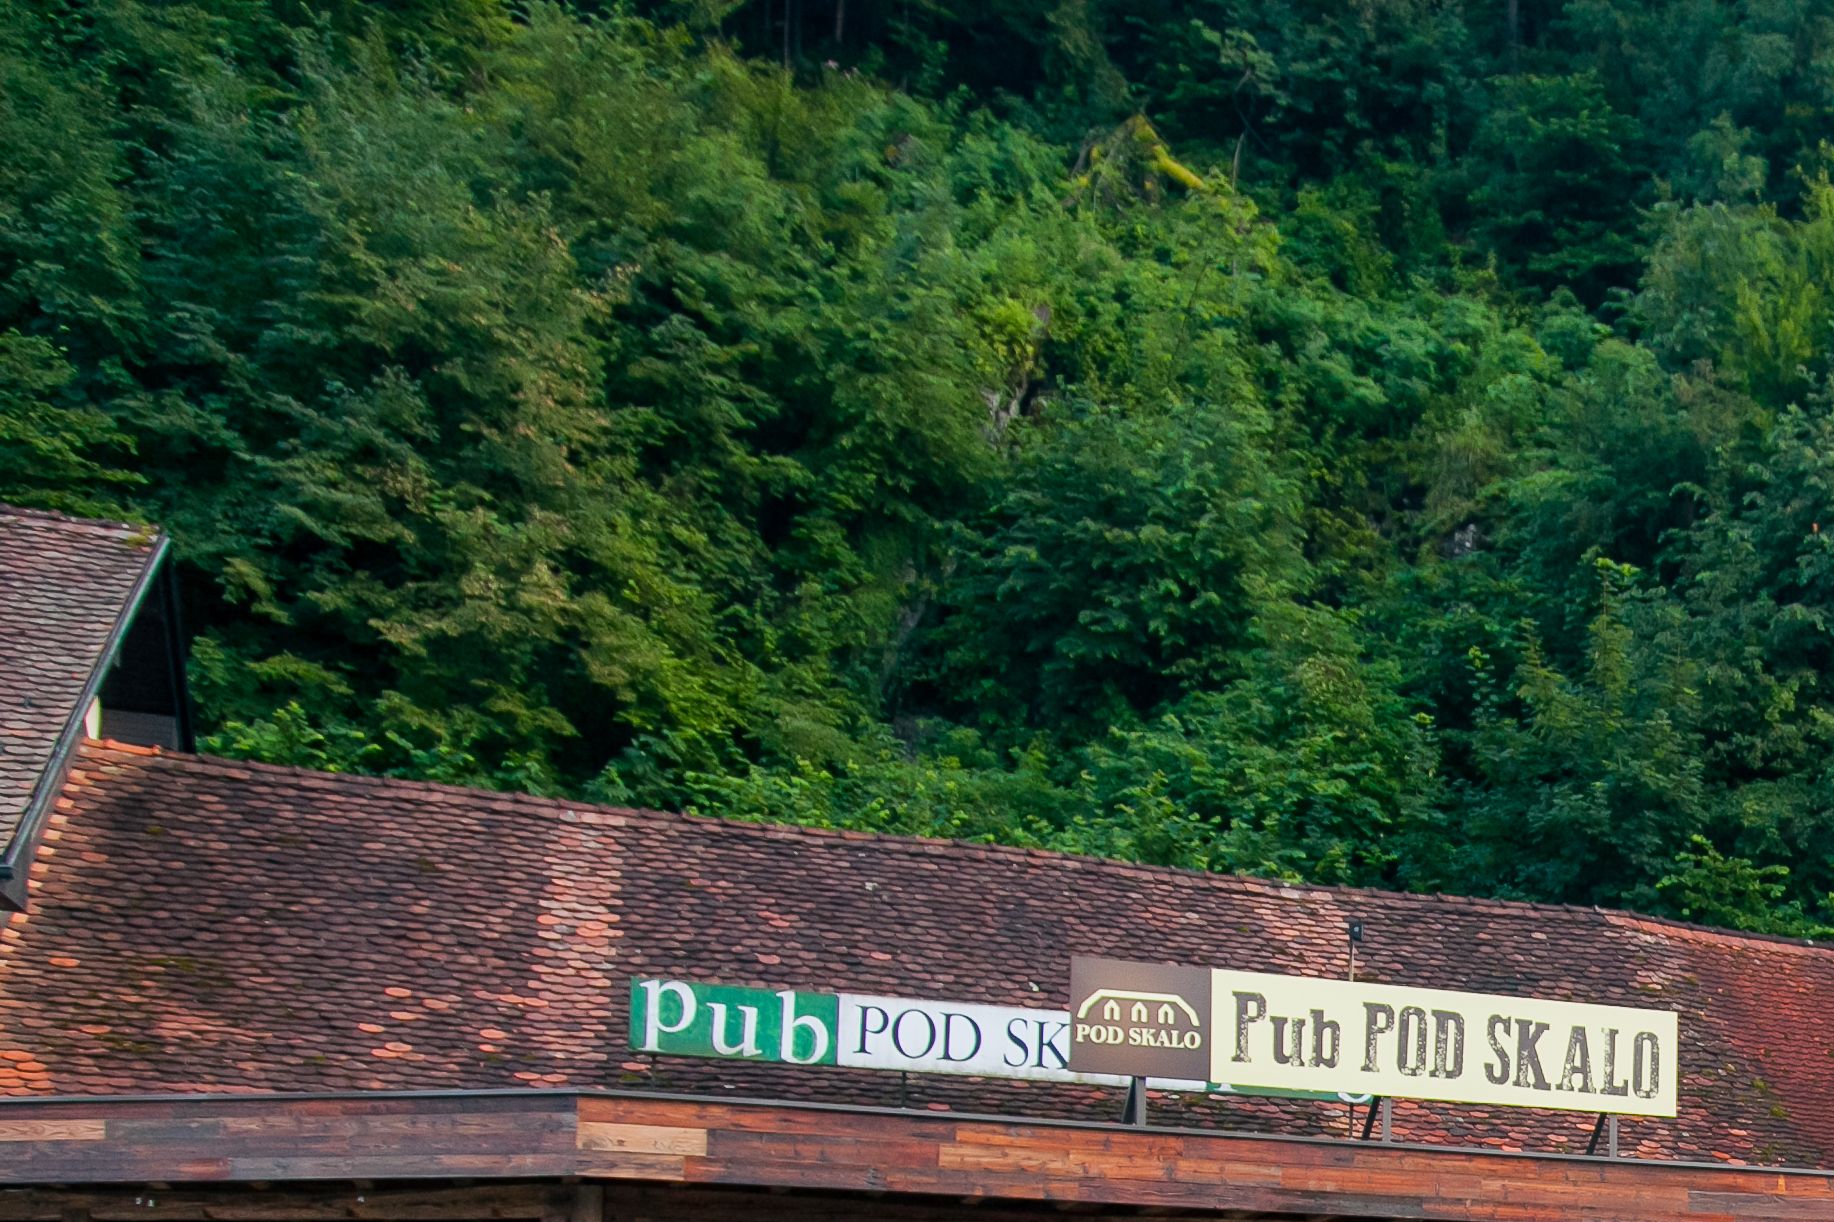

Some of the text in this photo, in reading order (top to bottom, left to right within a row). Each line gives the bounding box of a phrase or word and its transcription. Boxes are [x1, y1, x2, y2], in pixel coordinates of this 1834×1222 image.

[853, 1004, 982, 1062] POD
[1003, 1017, 1070, 1070] SK
[1075, 1023, 1202, 1049] POD SKALO
[1231, 990, 1662, 1100] Pub POD SKALO
